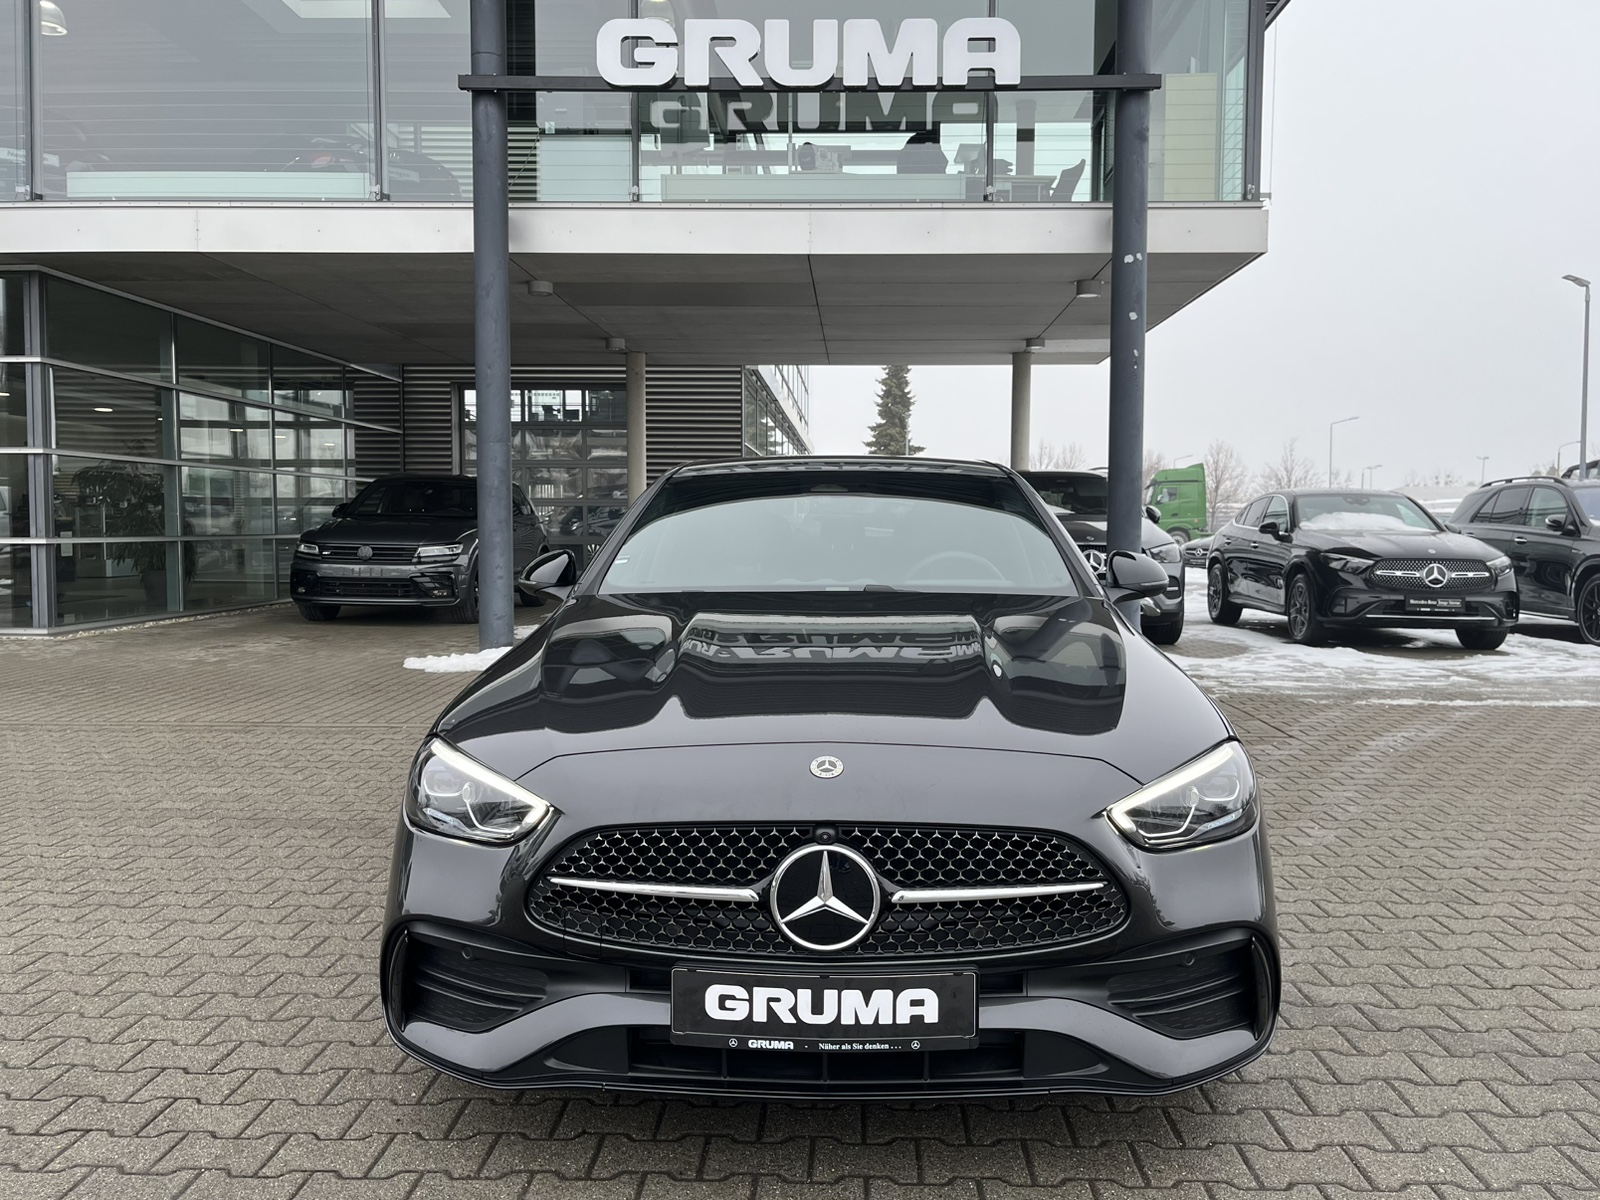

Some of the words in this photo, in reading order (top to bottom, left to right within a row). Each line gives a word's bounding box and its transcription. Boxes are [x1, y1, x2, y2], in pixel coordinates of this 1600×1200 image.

[596, 17, 1021, 87] GRUMA
[704, 984, 939, 1025] GRUMA
[748, 1039, 794, 1050] GRUMA
[818, 1042, 840, 1051] Näher
[841, 1042, 852, 1051] als
[852, 1042, 864, 1051] Sie
